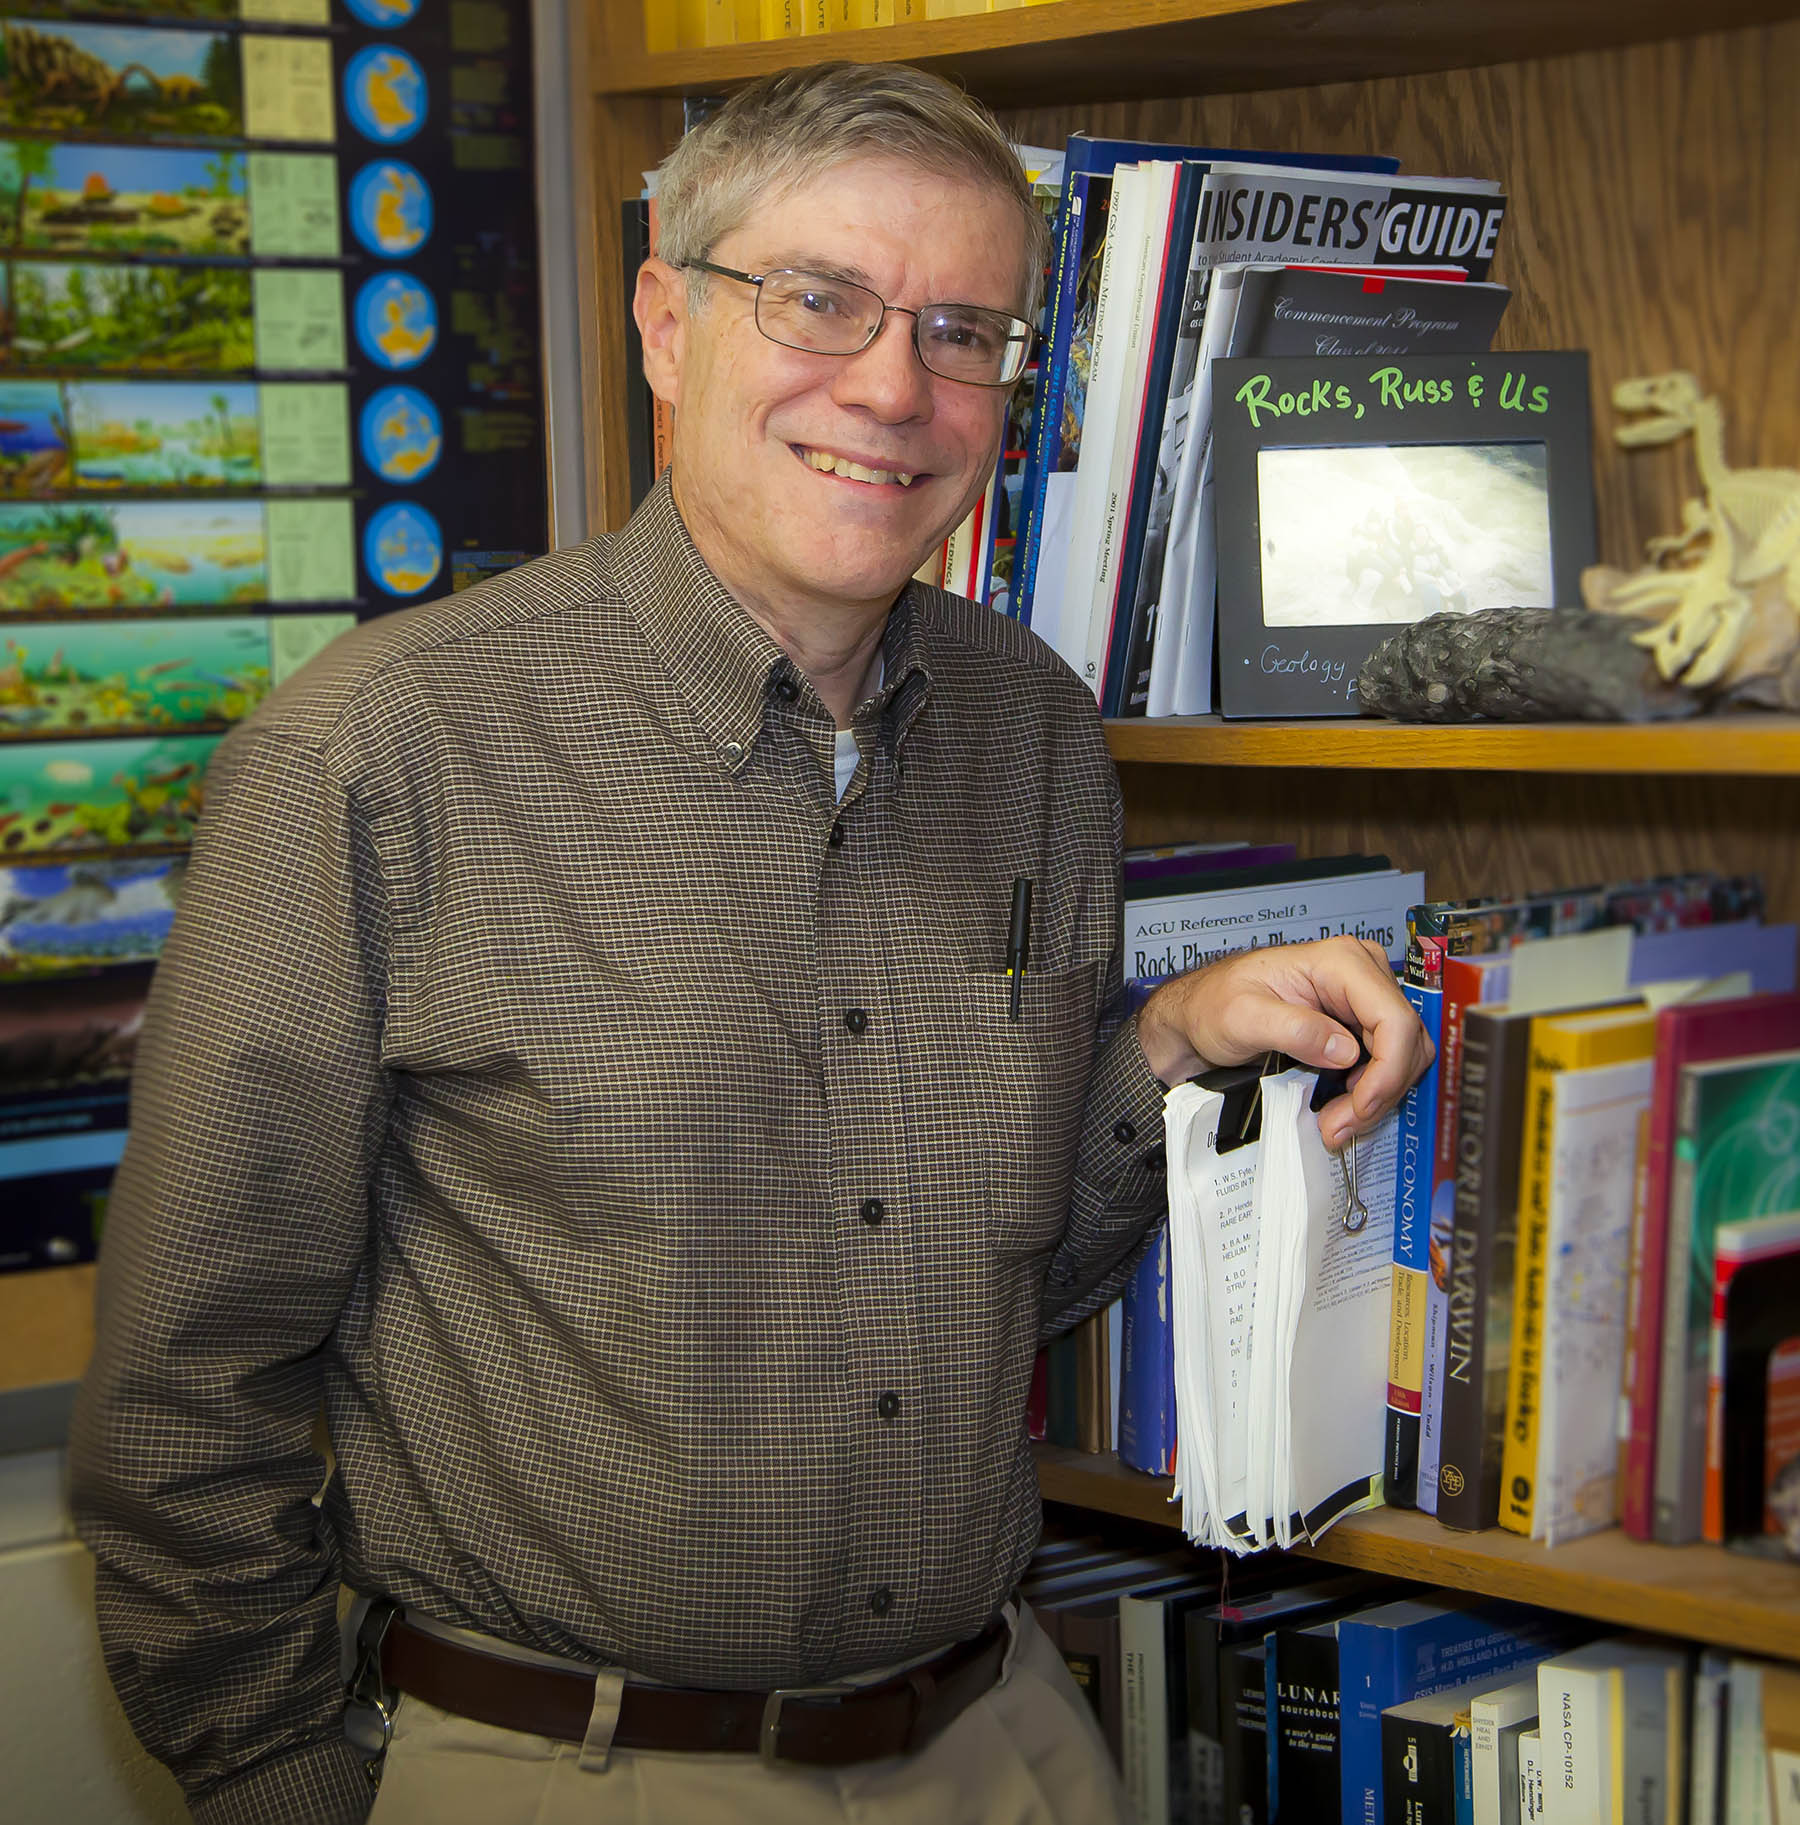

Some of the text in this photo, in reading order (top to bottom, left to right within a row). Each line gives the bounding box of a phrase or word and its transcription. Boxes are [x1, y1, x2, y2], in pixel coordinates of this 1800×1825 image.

[1108, 214, 1119, 236] GSA
[1196, 187, 1504, 259] INSIDERS' GUIDE
[1103, 237, 1114, 284] ANNUAL
[1097, 286, 1109, 332] MEETING
[1273, 296, 1458, 336] Commencement Program
[1091, 334, 1104, 383] PROGRAM
[1315, 334, 1353, 356] Class
[1235, 374, 1366, 428] Rocks,
[1369, 366, 1454, 411] Russ
[1499, 371, 1550, 413] Us
[1105, 516, 1114, 550] Spring
[946, 532, 956, 585] EEDINGS
[1099, 551, 1111, 584] Meeting
[1260, 644, 1347, 684] Geology
[1135, 904, 1308, 938] AGU Reference Shelf 3
[1135, 945, 1176, 978] Rock
[1215, 1183, 1241, 1197] FLUIDS
[1240, 1180, 1249, 1189] IN
[1400, 1087, 1419, 1259] RLD ECONOMY
[1220, 1216, 1238, 1230] RARE
[1448, 1060, 1488, 1384] BEFORE DARWIN
[1427, 1363, 1437, 1398] Wilson
[1277, 1682, 1340, 1705] LUNAR
[1365, 1675, 1371, 1688] 1
[1280, 1704, 1340, 1720] sourcebook
[1297, 1738, 1311, 1748] the
[1314, 1732, 1337, 1744] guide
[1562, 1692, 1574, 1790] NASA CP-10152
